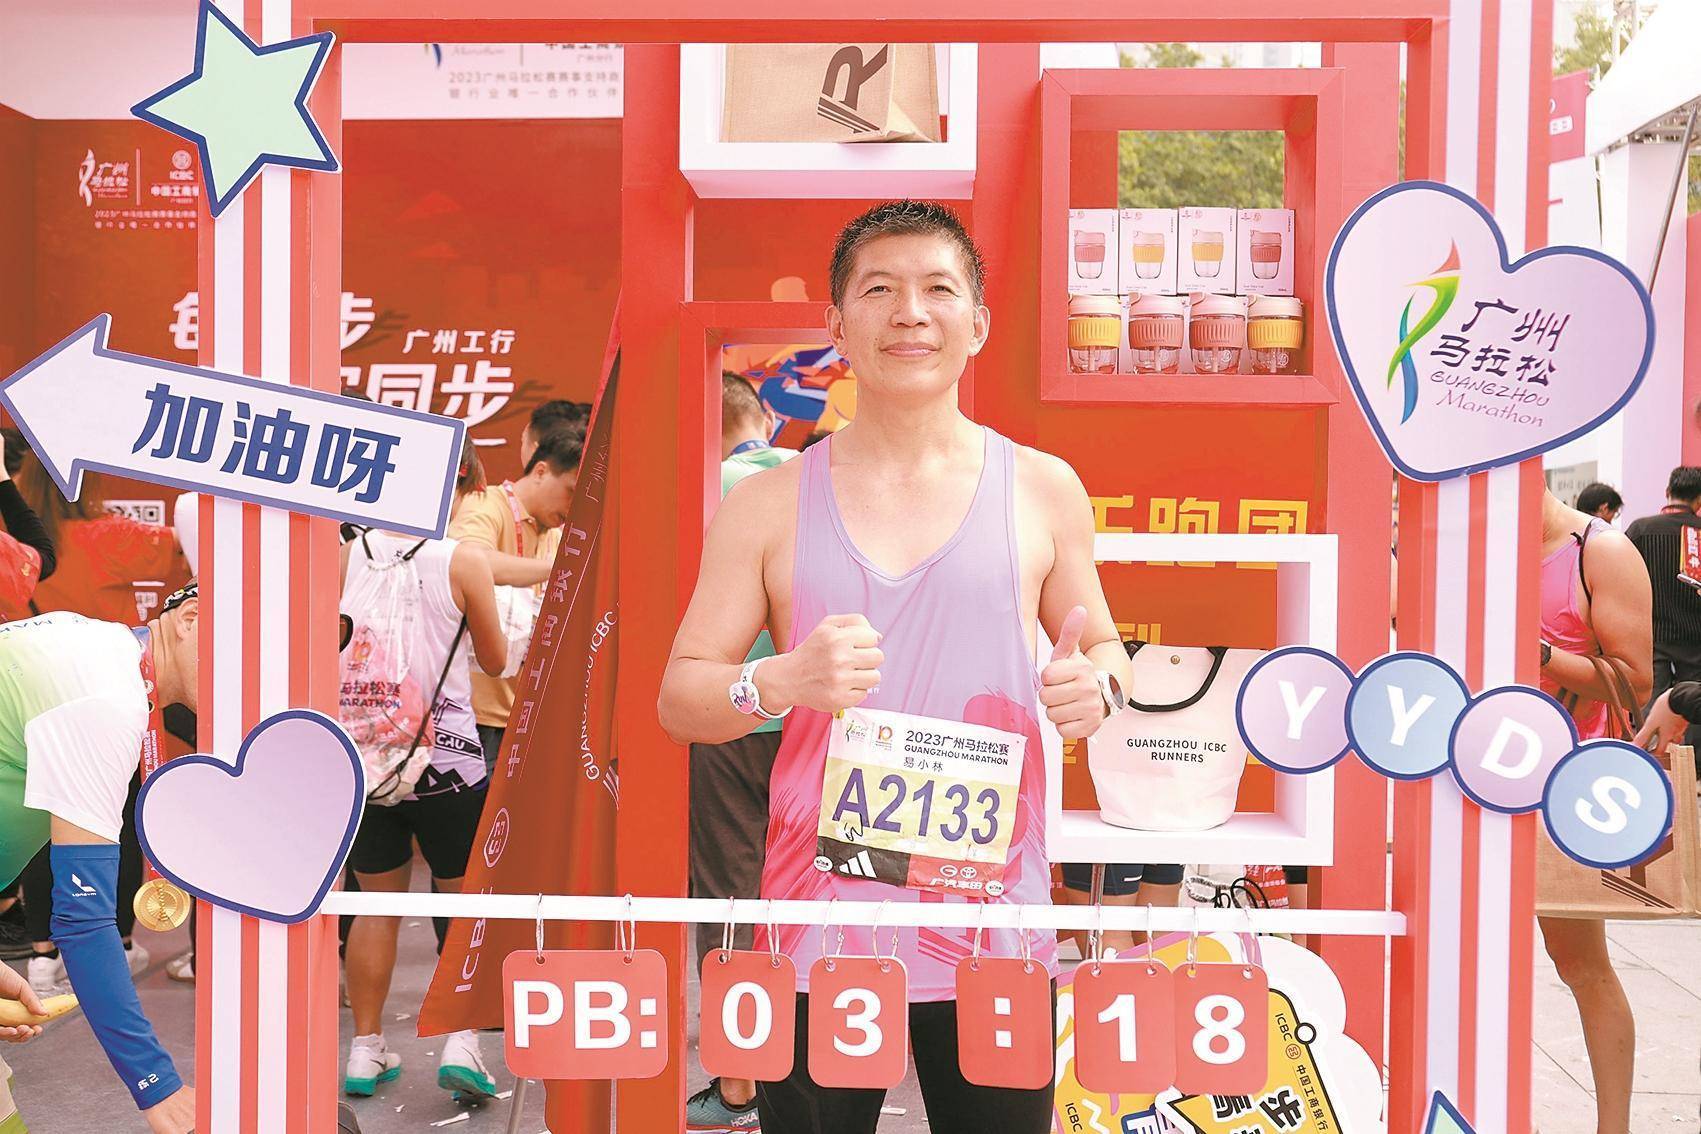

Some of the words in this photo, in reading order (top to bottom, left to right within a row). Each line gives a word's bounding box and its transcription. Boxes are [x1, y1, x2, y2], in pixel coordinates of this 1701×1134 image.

[402, 329, 516, 354] 广州工行
[1461, 299, 1570, 352] 广州
[1430, 334, 1556, 386] 马拉松
[1430, 371, 1551, 407] GUANGZHOU
[1436, 390, 1544, 427] Marathon
[131, 383, 401, 504] 加油呀
[590, 610, 618, 653] ICBC
[904, 744, 961, 760] GUANGZHOU
[961, 753, 1009, 766] MARATHON
[905, 730, 1010, 756] 2023广州马拉松赛
[1126, 738, 1199, 750] GUANGZHOU
[1203, 742, 1228, 753] ICBC
[1151, 751, 1205, 764] RUNNERS
[903, 756, 944, 773] 易小林
[831, 767, 1001, 845] A2133
[455, 887, 494, 994] ICB
[512, 980, 658, 1050] PB:
[1274, 1012, 1294, 1042] ICBC
[1294, 1063, 1330, 1132] 中国工商银行
[731, 1112, 758, 1127] HOKA
[1064, 1102, 1083, 1132] ICBC
